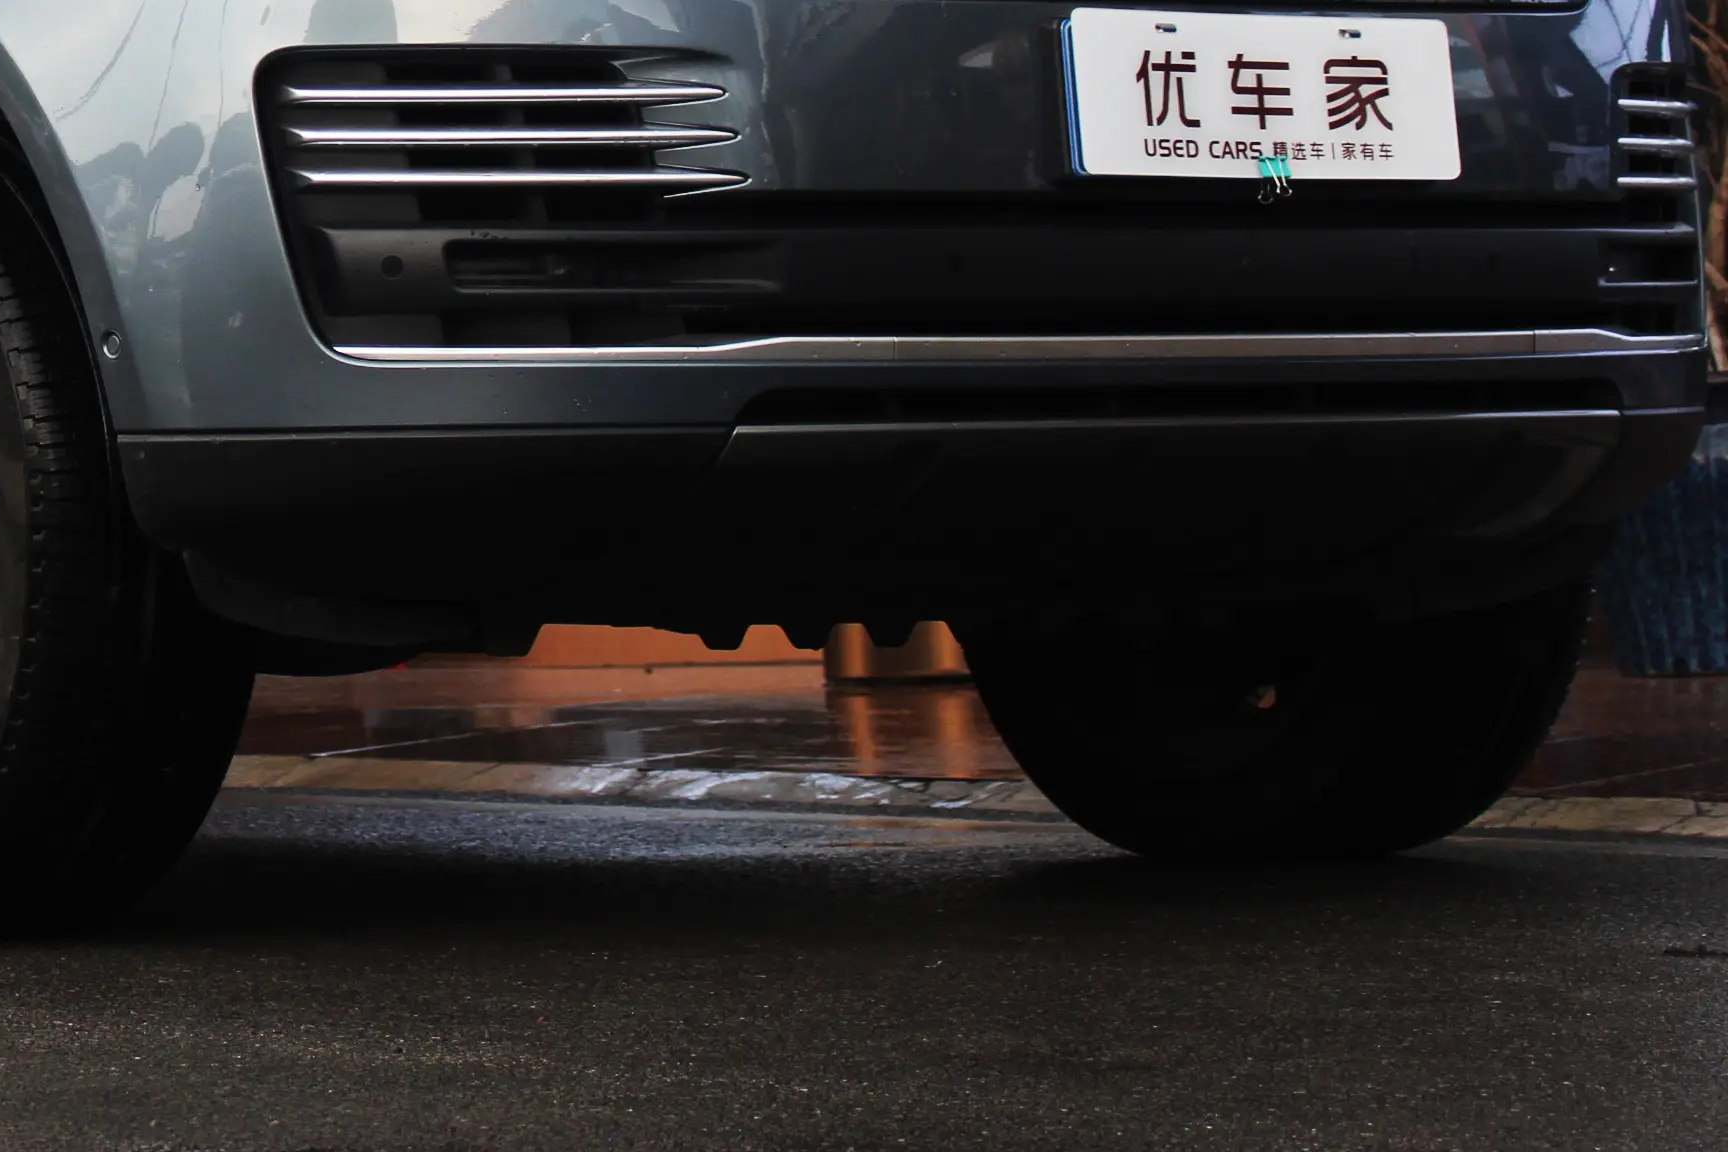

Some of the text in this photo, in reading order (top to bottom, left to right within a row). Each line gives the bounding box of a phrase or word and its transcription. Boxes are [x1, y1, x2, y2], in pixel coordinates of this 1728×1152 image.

[1135, 49, 1394, 131] 优车家
[1143, 138, 1264, 161] USED CARS
